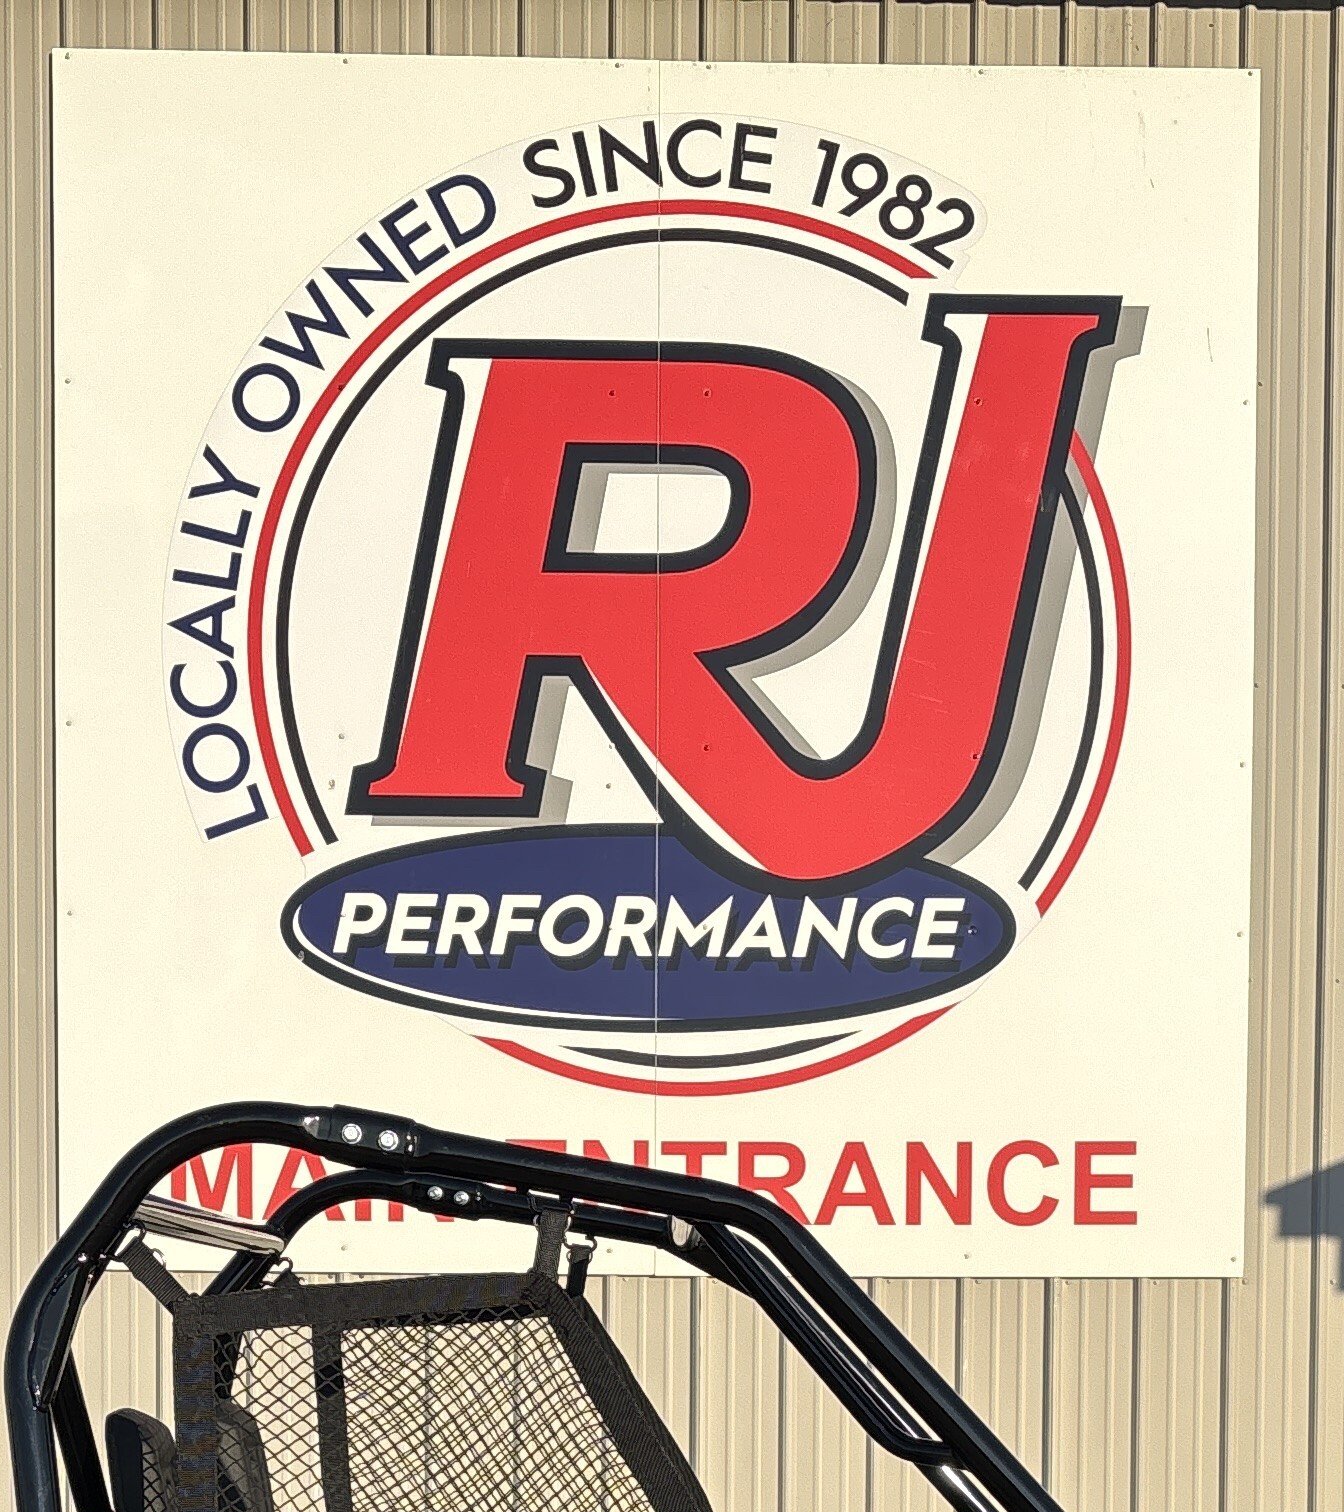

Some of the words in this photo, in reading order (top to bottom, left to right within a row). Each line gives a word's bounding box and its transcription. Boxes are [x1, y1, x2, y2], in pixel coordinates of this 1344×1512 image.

[168, 445, 270, 841] LOCALLY
[232, 174, 497, 433] OWNED
[522, 118, 778, 209] SINCE
[811, 137, 975, 271] 1982
[346, 294, 1124, 894] RJ
[331, 892, 968, 962] PERFORMANCE
[169, 1142, 456, 1223] MA
